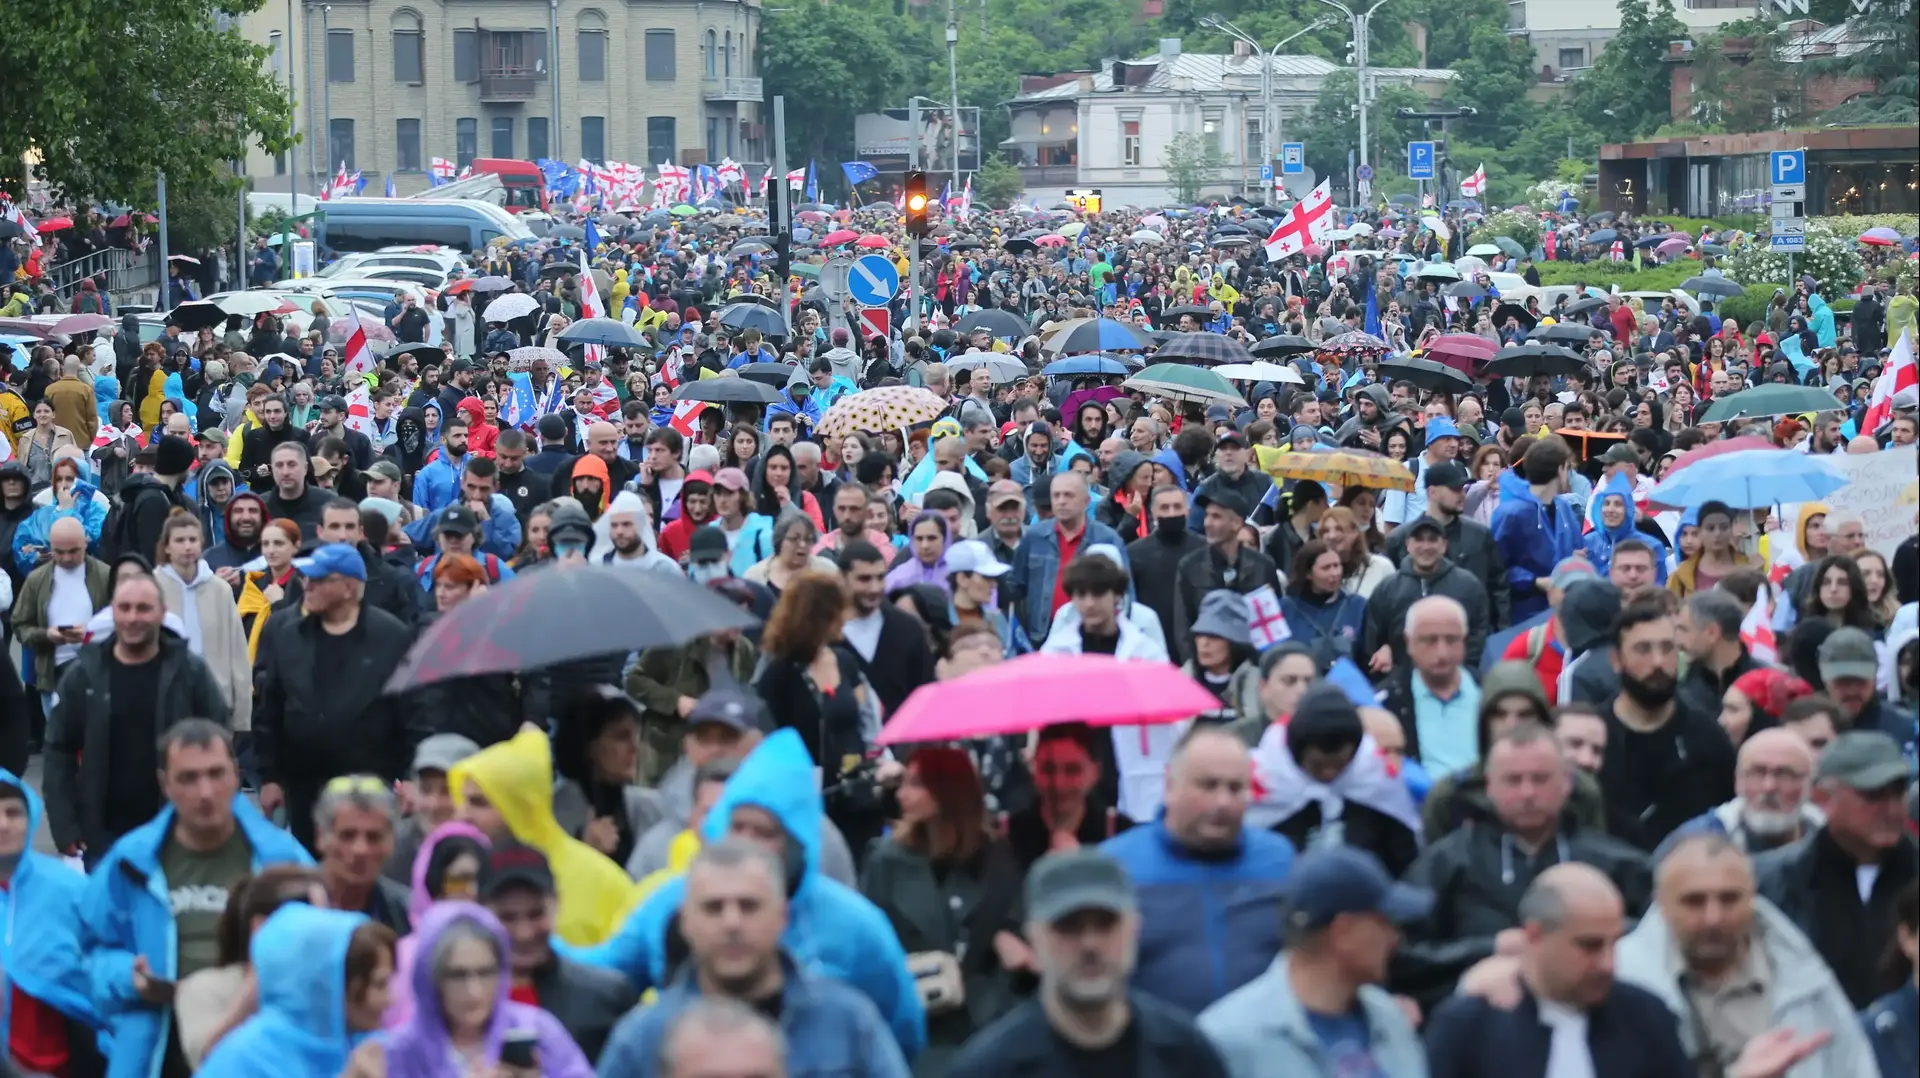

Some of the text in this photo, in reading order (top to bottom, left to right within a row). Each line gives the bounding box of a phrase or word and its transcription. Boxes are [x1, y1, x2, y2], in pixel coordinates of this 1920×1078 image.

[1416, 148, 1426, 160] P
[1263, 167, 1269, 179] P
[1779, 155, 1797, 181] P
